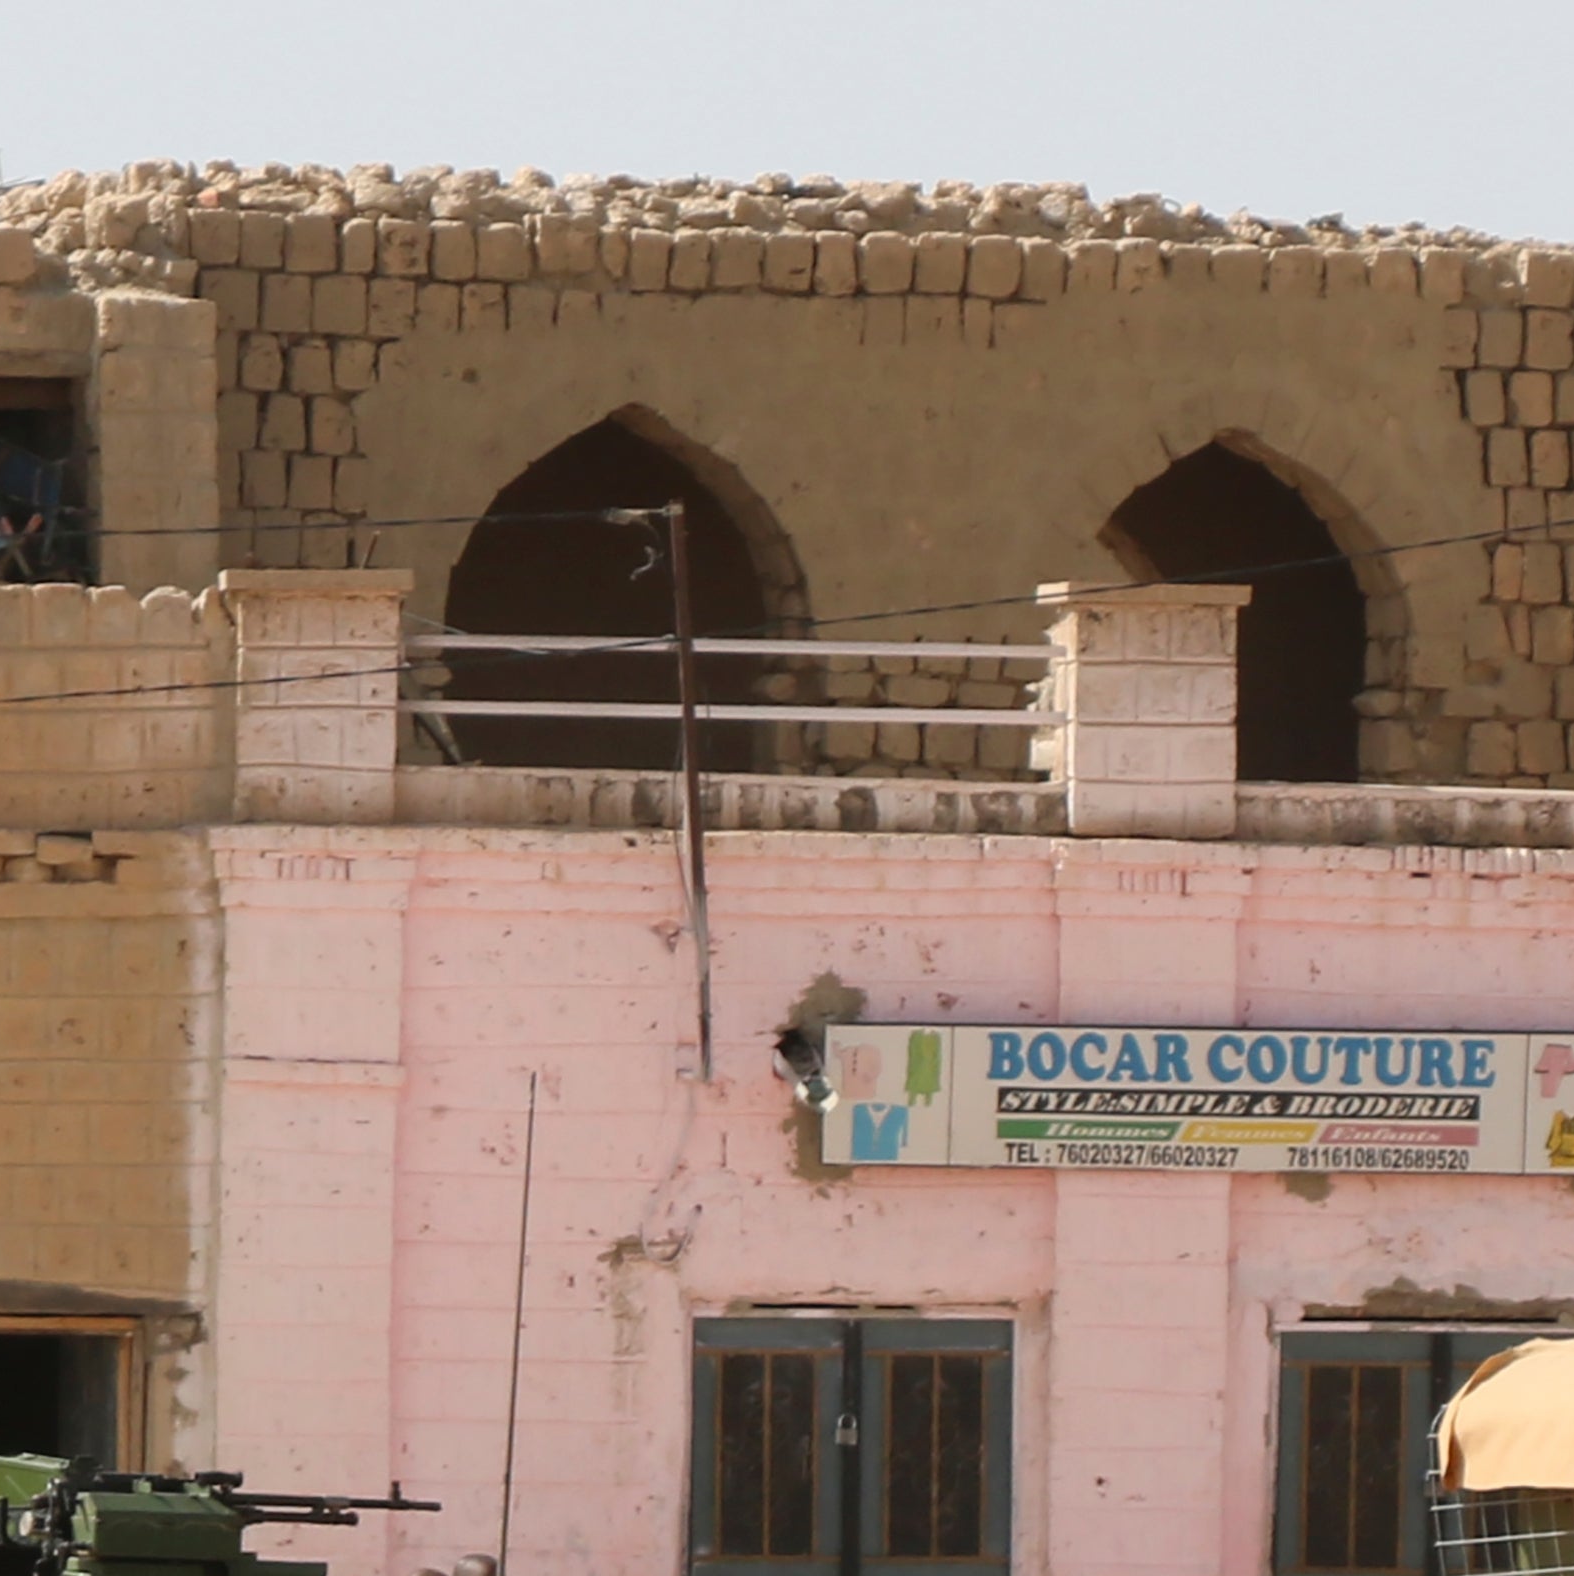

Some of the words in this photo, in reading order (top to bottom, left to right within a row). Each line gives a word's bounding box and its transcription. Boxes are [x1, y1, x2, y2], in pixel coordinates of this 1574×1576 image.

[987, 1032, 1193, 1083] BOCAR
[1207, 1034, 1496, 1088] COUTURE
[1252, 1095, 1282, 1116] &
[1286, 1094, 1476, 1118] BRODERIE
[1044, 1122, 1171, 1138] Hommes
[1192, 1124, 1308, 1140] Femmes
[1329, 1125, 1441, 1142] Enfants
